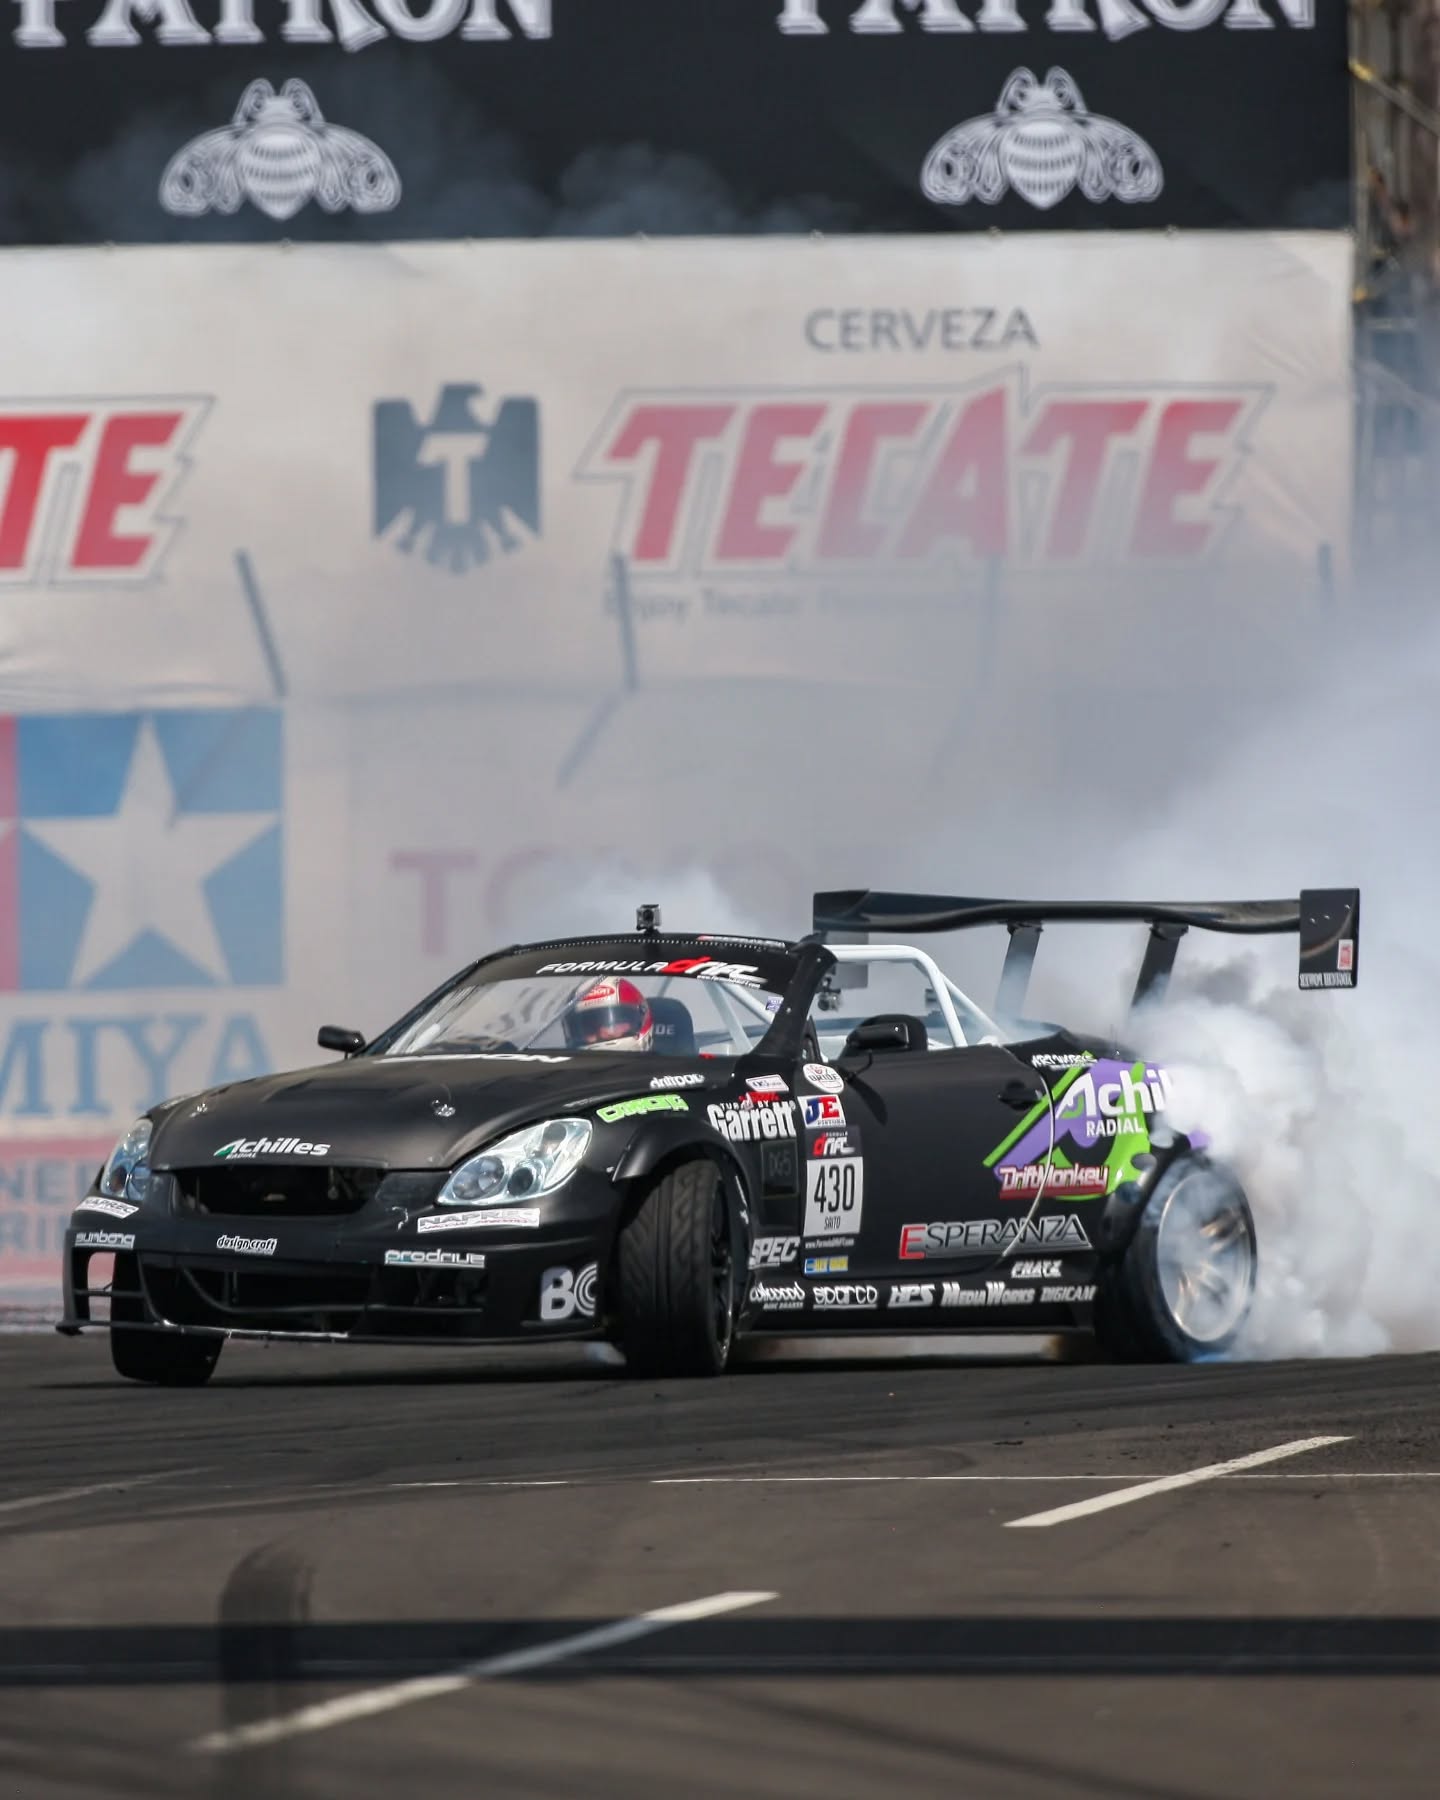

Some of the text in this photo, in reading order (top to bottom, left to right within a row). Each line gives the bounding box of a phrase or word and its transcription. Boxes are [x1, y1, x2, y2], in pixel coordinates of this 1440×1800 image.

[804, 308, 1040, 352] CERVEZA
[603, 385, 1246, 562] TECATE
[0, 412, 185, 570] TE
[536, 960, 669, 975] FORMULA
[707, 1101, 796, 1141] Garrett
[805, 1095, 841, 1126] JE
[1086, 1117, 1144, 1137] RADIAL
[213, 1137, 331, 1156] Achilles
[813, 1163, 856, 1213] 430
[1000, 1161, 1108, 1191] DriftMonkey
[824, 1216, 841, 1231] SAITO
[899, 1213, 1092, 1259] ESPERANZA
[385, 1249, 486, 1268] prodrive
[750, 1236, 801, 1264] SPEC
[813, 1285, 878, 1304] sparco
[1040, 1286, 1098, 1303] DIGICAM
